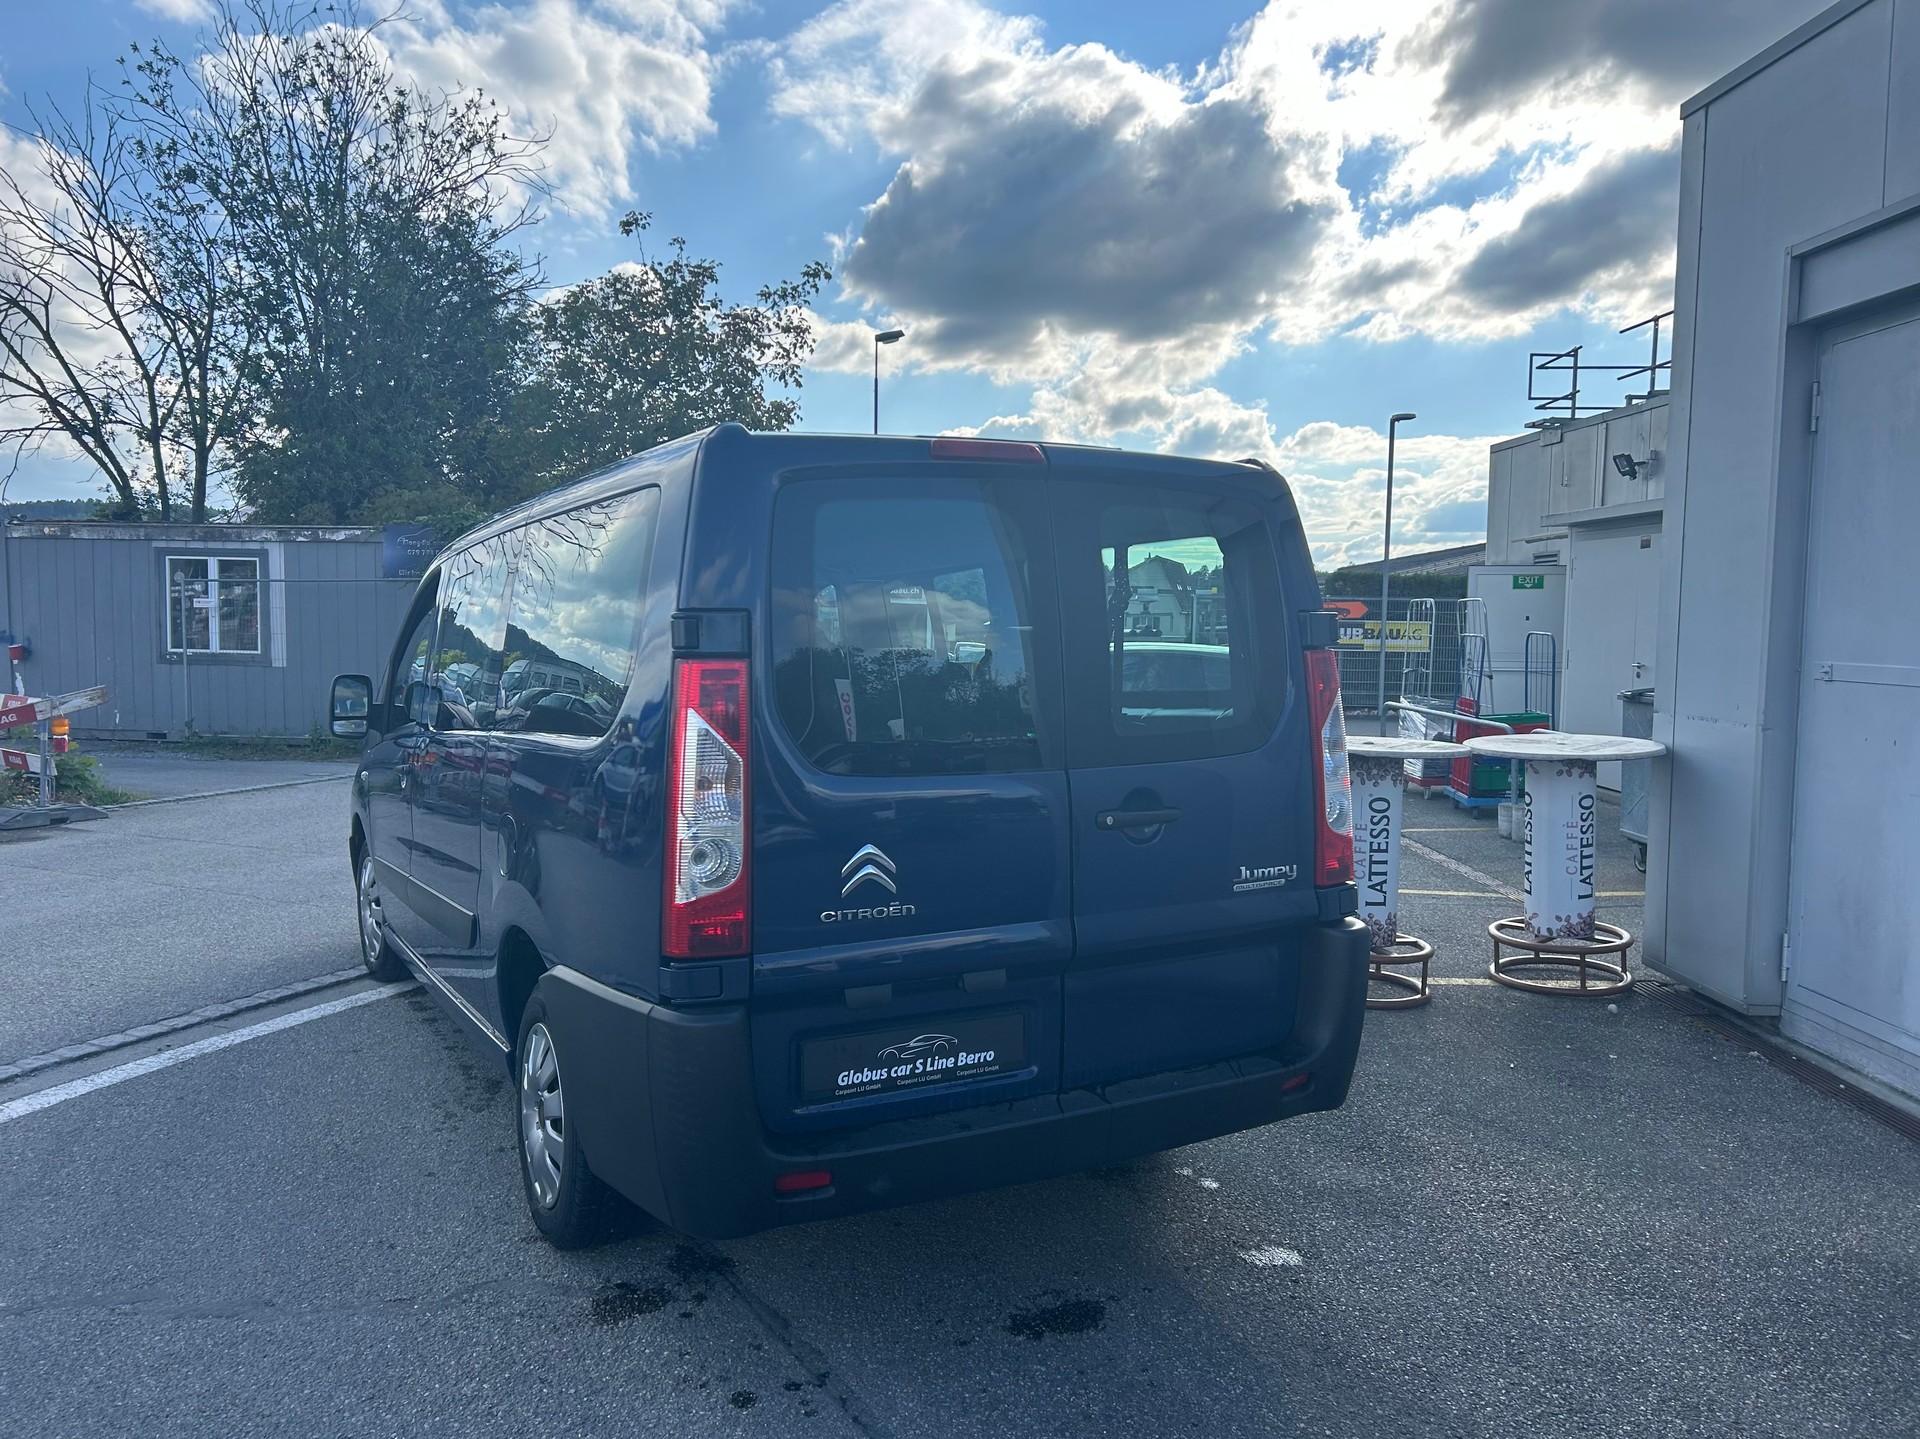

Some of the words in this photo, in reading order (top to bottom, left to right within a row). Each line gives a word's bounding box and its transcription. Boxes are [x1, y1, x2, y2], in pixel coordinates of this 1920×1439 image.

[1518, 576, 1539, 584] EXIT
[1365, 796, 1391, 907] LATTESSO
[1562, 821, 1578, 875] CAFFÈ
[1578, 793, 1595, 900] LATTESSO
[1233, 864, 1297, 881] Jumpy
[837, 1067, 888, 1086] Globus
[890, 1062, 914, 1078] car
[914, 1058, 924, 1074] S
[926, 1056, 955, 1072] Line
[957, 1050, 995, 1067] Berro
[956, 1067, 977, 1076] Carpoint
[984, 1064, 999, 1072] GmbH
[897, 1076, 918, 1086] Carpoint
[926, 1073, 942, 1082] GmbH
[835, 1085, 857, 1096] Carpoint
[865, 1083, 881, 1091] GmbH
